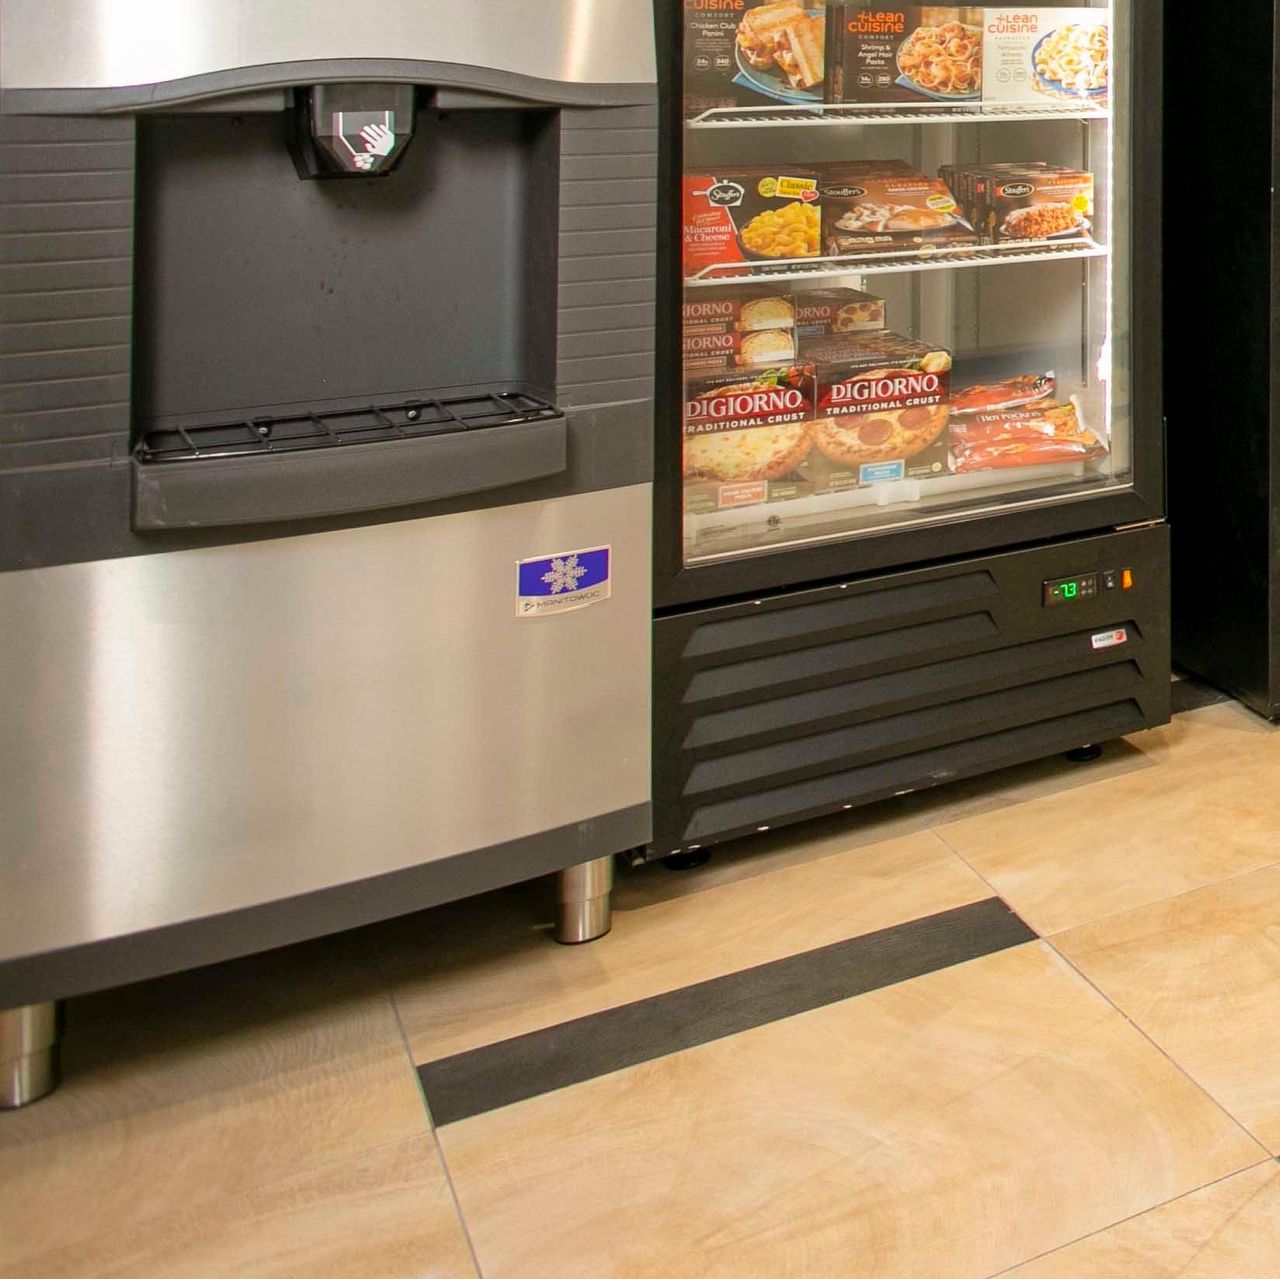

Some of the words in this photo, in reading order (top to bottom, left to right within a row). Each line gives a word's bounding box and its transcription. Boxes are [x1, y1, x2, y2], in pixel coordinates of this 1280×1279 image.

[869, 11, 905, 22] Lean
[860, 44, 884, 52] Shrimp
[857, 51, 877, 59] Angel
[684, 224, 732, 234] Macaroni
[694, 232, 730, 241] Cheese
[826, 401, 902, 416] TRADITIONAL
[906, 395, 941, 406] CRUST
[768, 412, 805, 423] CRUST
[536, 590, 600, 609] MANITOWOC
